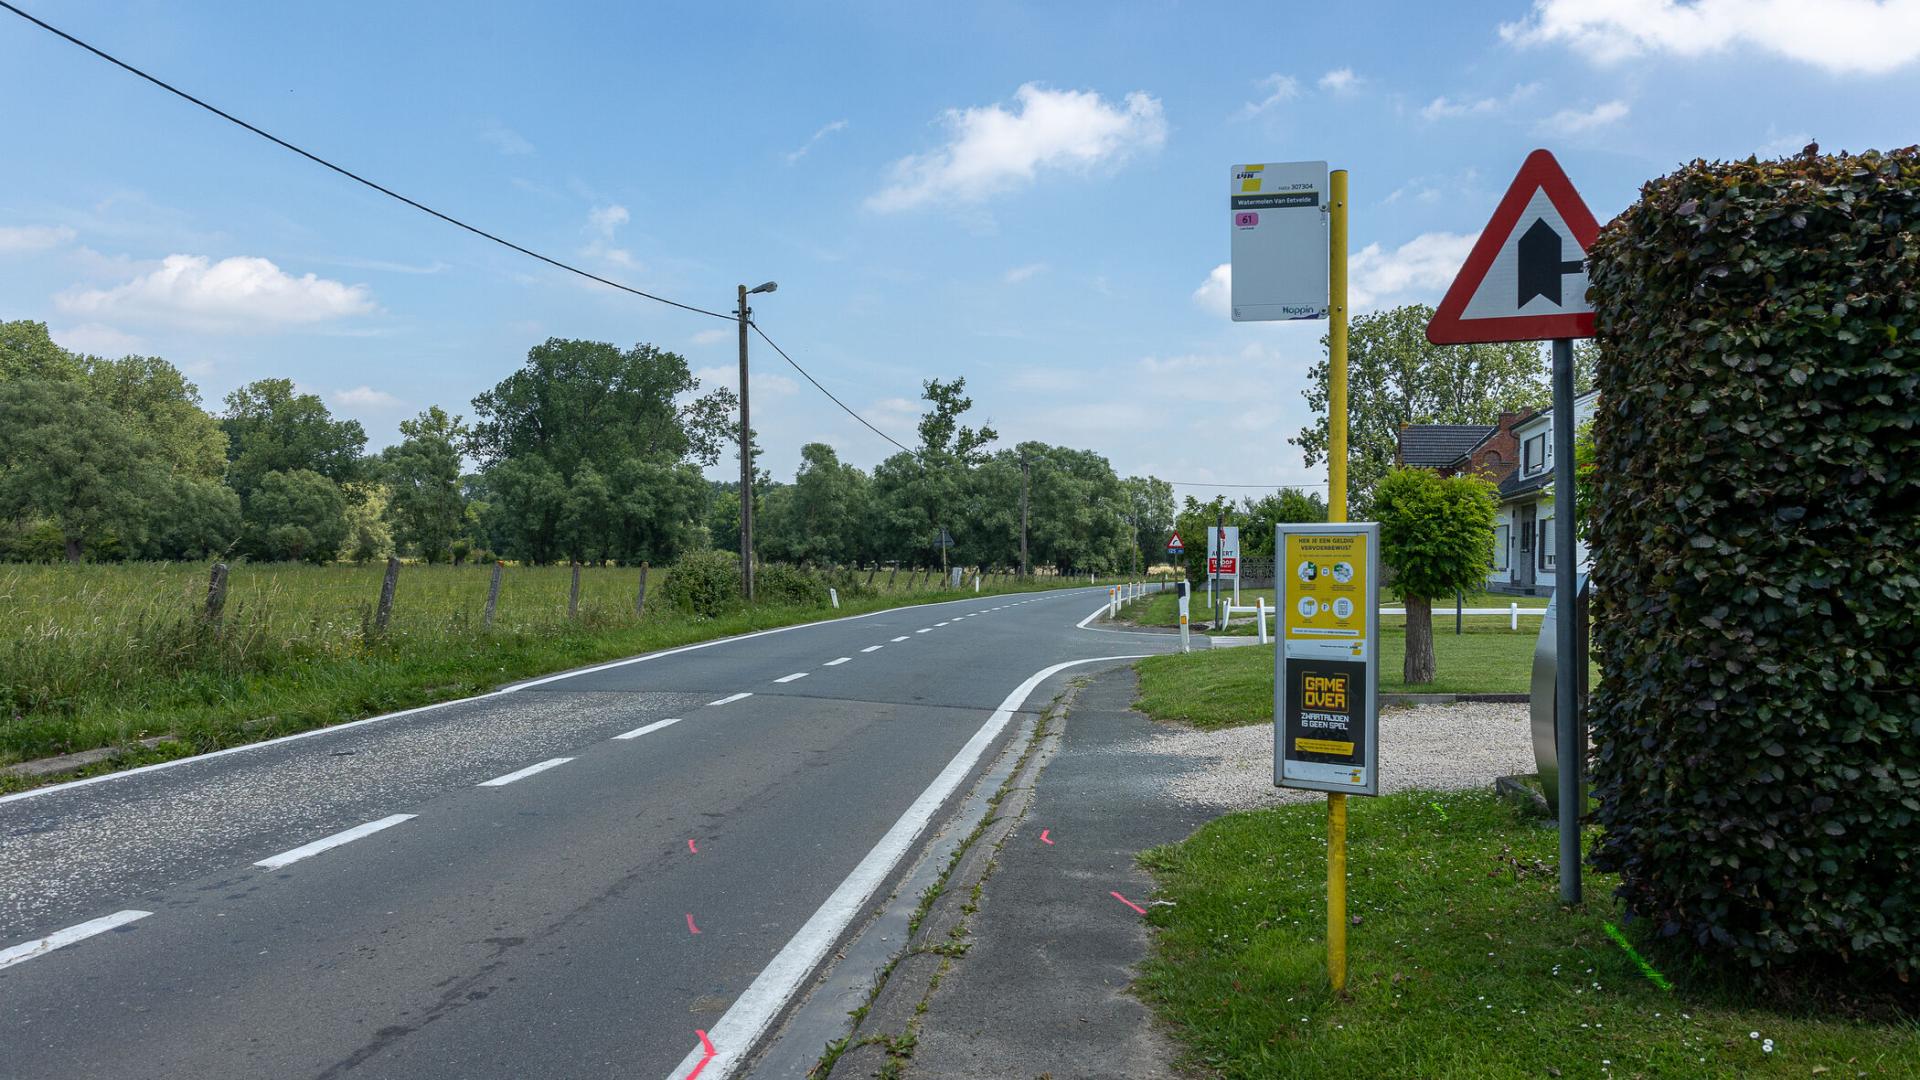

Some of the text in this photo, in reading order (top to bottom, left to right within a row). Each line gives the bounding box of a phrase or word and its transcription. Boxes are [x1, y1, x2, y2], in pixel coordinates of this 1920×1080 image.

[1290, 183, 1313, 191] 307304
[1237, 197, 1273, 206] Watermolen
[1286, 196, 1312, 204] Eetvelde
[1242, 215, 1252, 224] 61
[1282, 305, 1314, 315] Hoppin
[1305, 677, 1346, 693] GAME
[1305, 692, 1345, 708] OVER
[1301, 712, 1350, 723] ZWARTRIJDEN
[1309, 721, 1328, 729] GEEN
[1329, 722, 1348, 730] SPEL
